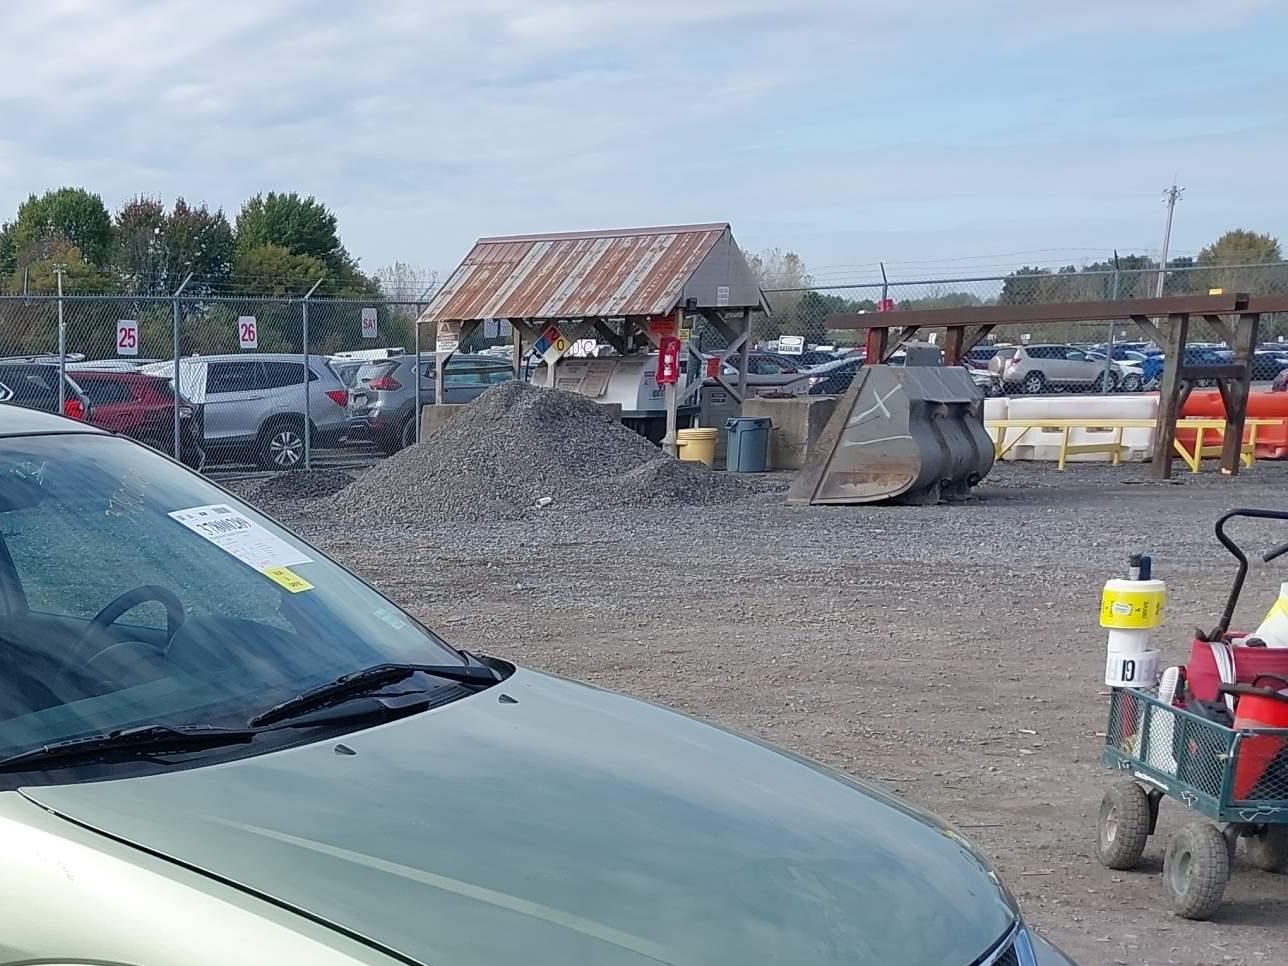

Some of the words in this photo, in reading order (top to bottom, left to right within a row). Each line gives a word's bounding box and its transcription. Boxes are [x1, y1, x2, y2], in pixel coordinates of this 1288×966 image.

[119, 327, 136, 348] 25
[240, 323, 256, 341] 26
[557, 338, 565, 351] 0
